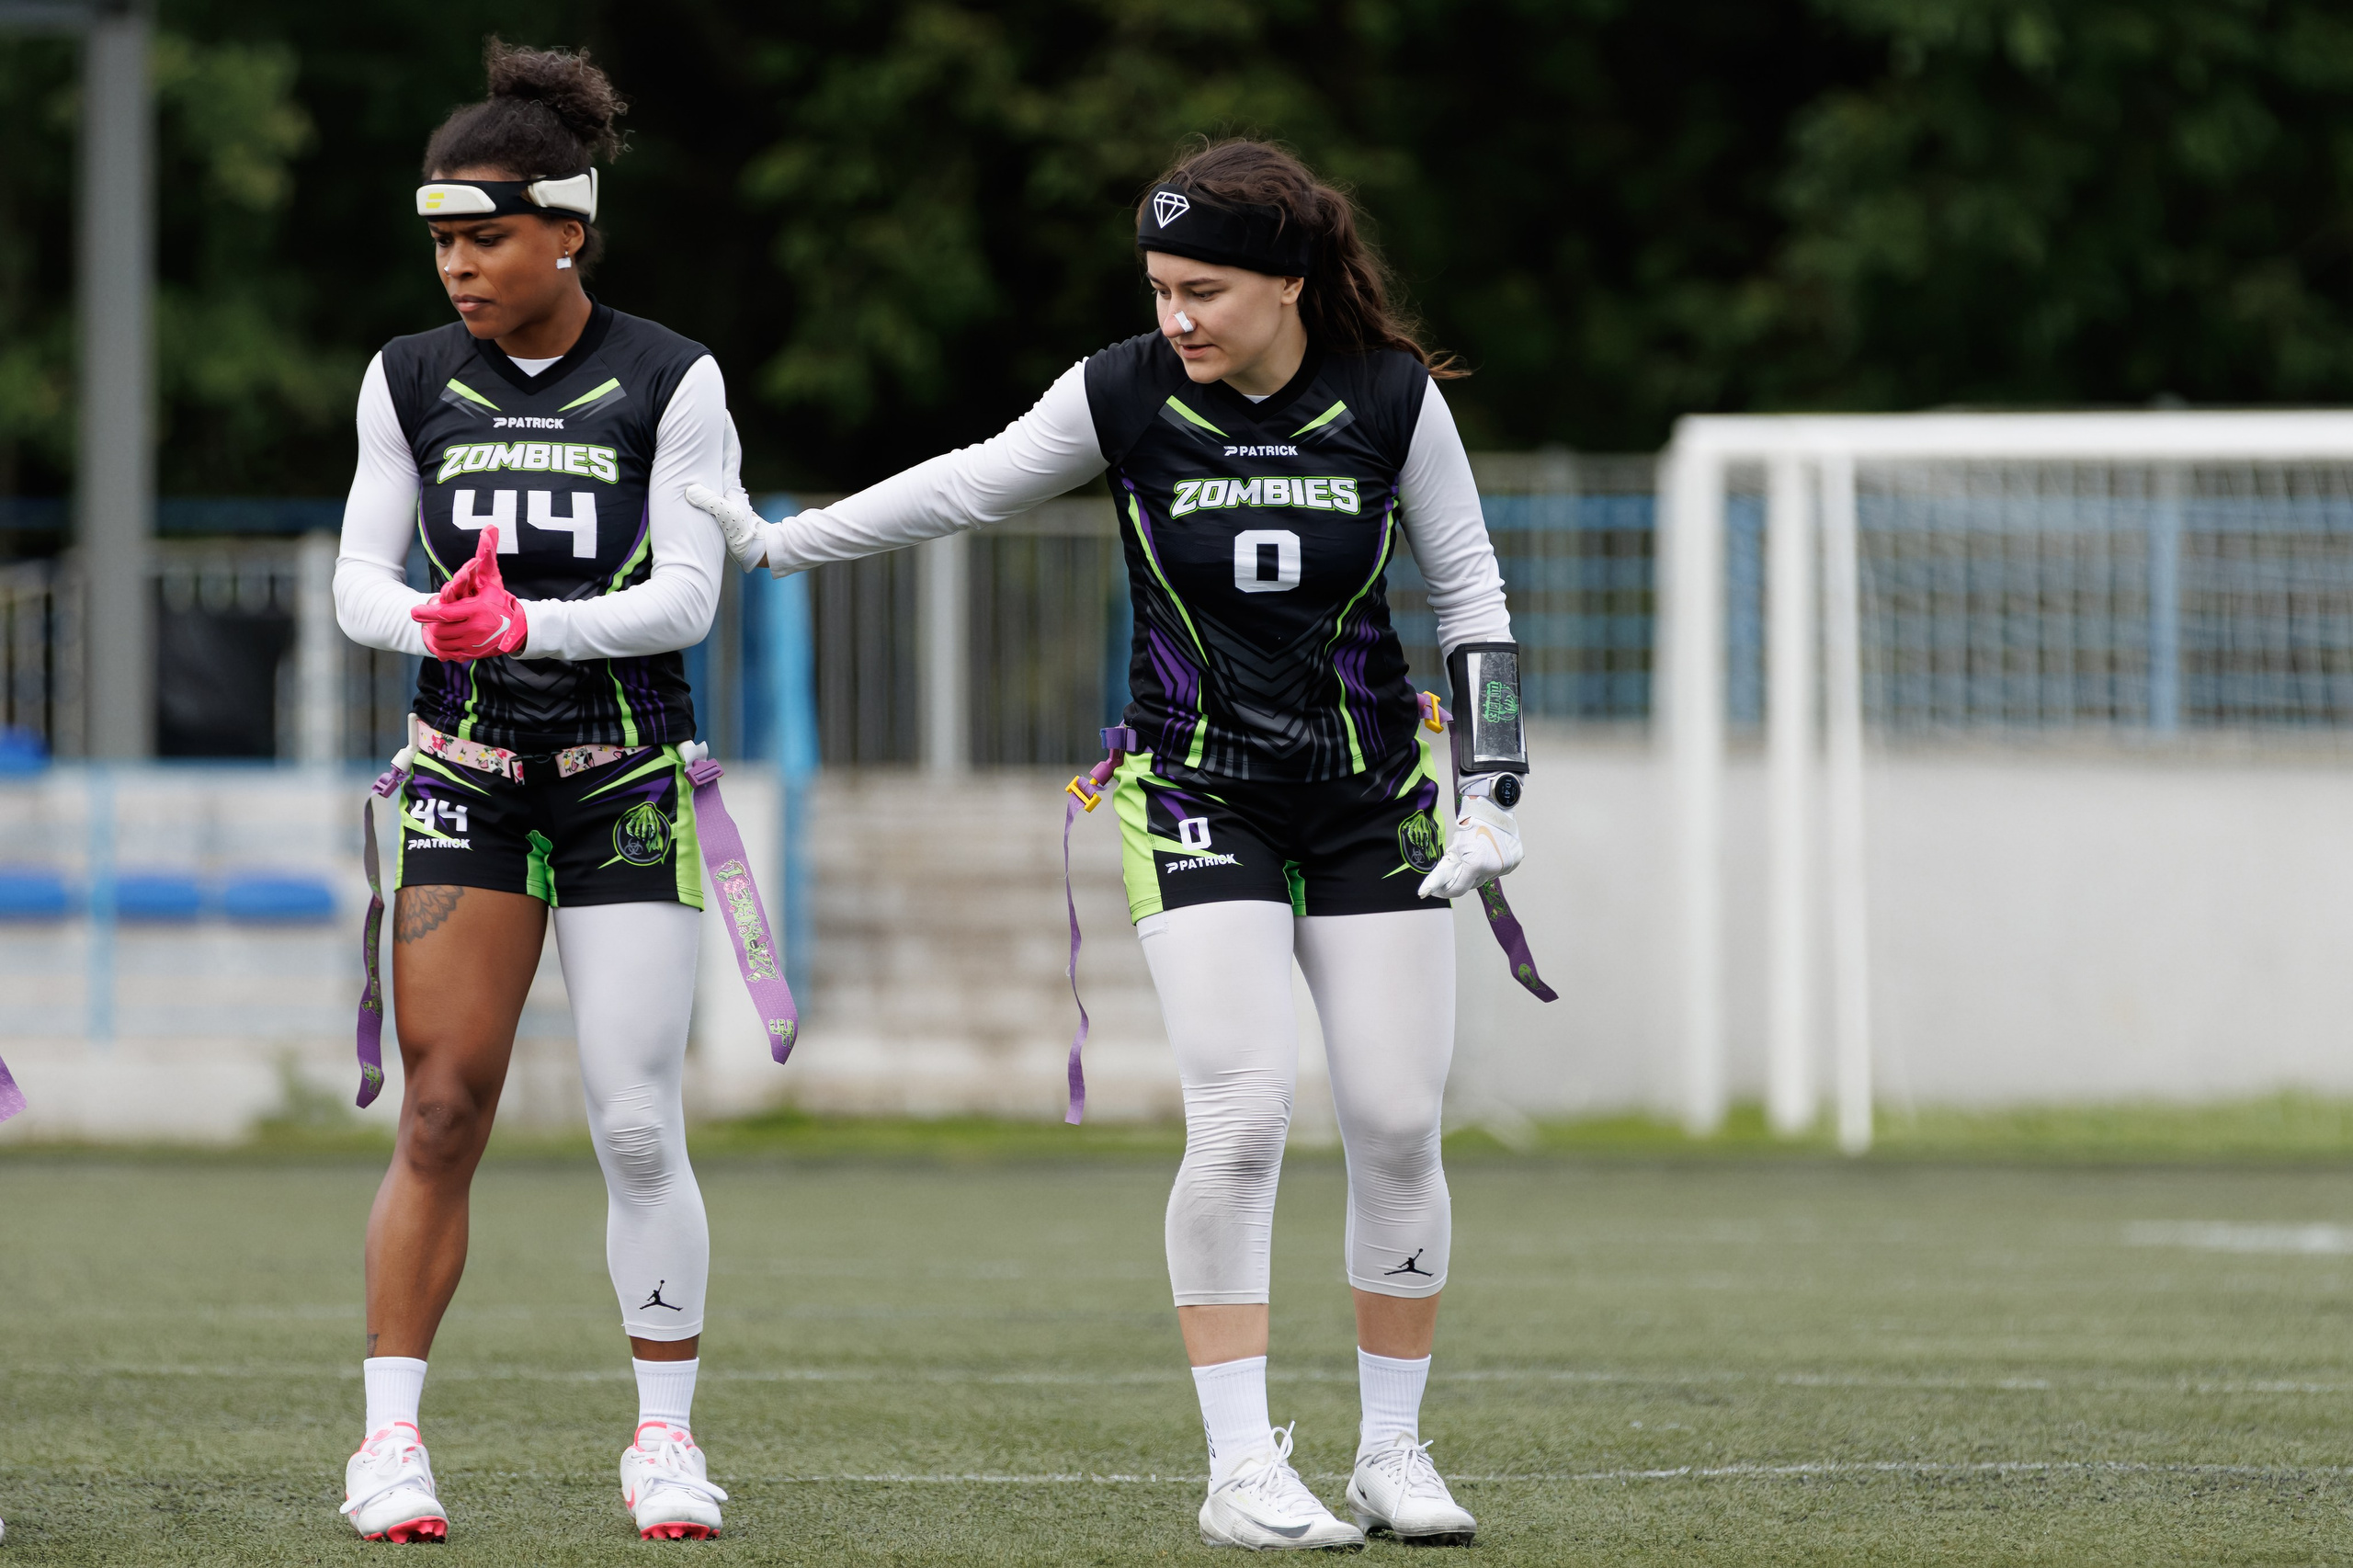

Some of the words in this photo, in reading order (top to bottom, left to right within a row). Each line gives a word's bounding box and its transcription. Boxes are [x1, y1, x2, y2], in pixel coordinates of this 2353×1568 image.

[507, 417, 564, 429] PATRICK
[437, 441, 620, 483] ZOMBIES
[1239, 445, 1299, 456] PATRICK
[1169, 476, 1361, 519] ZOMBIES
[452, 489, 597, 559] 44
[1233, 529, 1302, 593] 0
[410, 798, 468, 832] 44
[416, 837, 471, 849] PATRICK
[1178, 816, 1212, 851] 0
[1179, 853, 1236, 871] PATRICK
